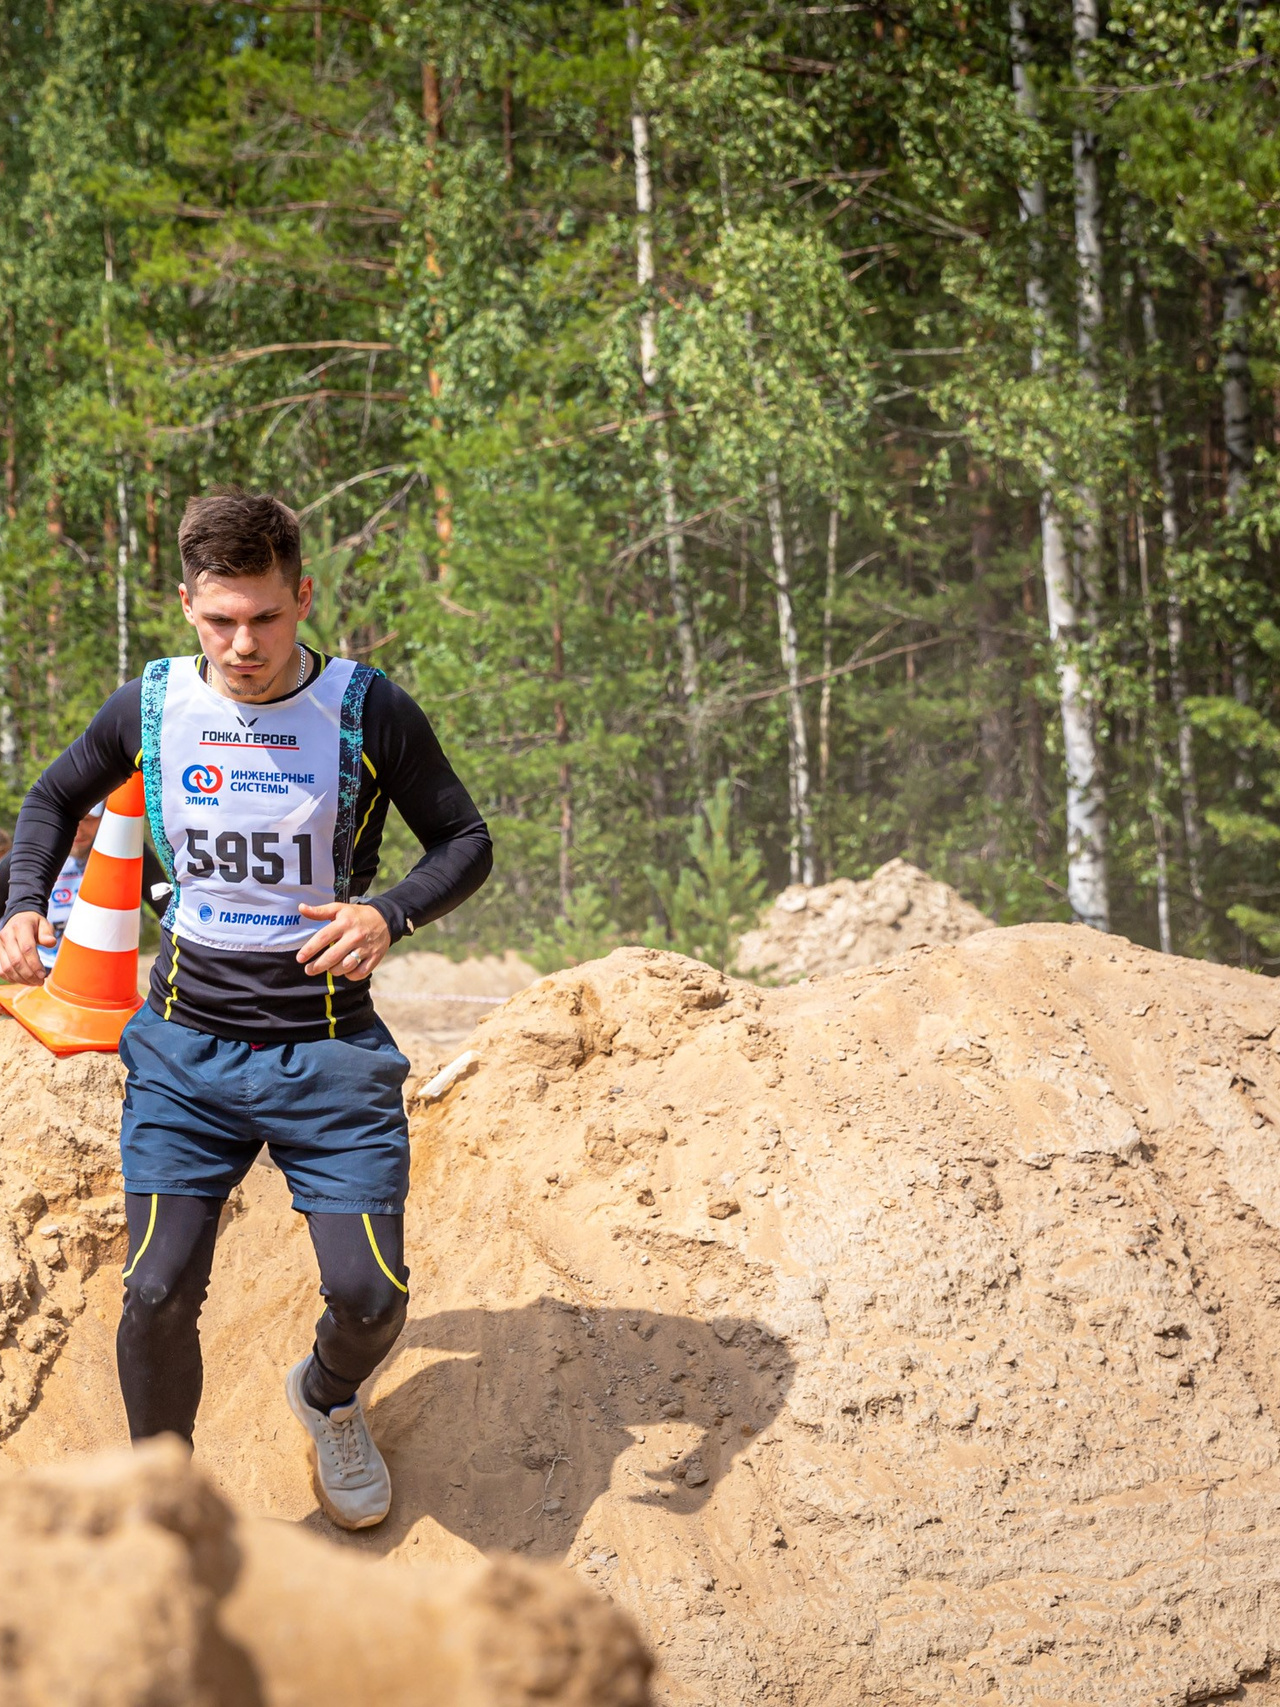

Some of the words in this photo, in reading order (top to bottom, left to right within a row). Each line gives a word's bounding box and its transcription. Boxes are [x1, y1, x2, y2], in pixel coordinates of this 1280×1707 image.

[202, 730, 241, 743] ГОНКА
[245, 733, 297, 746] ГЕРОЕВ
[230, 769, 315, 784] ИНЖЕНЕРНЫЕ
[230, 782, 289, 794] СИСТЕМЫ
[185, 796, 219, 806] ЭЛИТА
[185, 828, 313, 886] 5951
[219, 911, 301, 926] ГАЗПРОМБАНК
